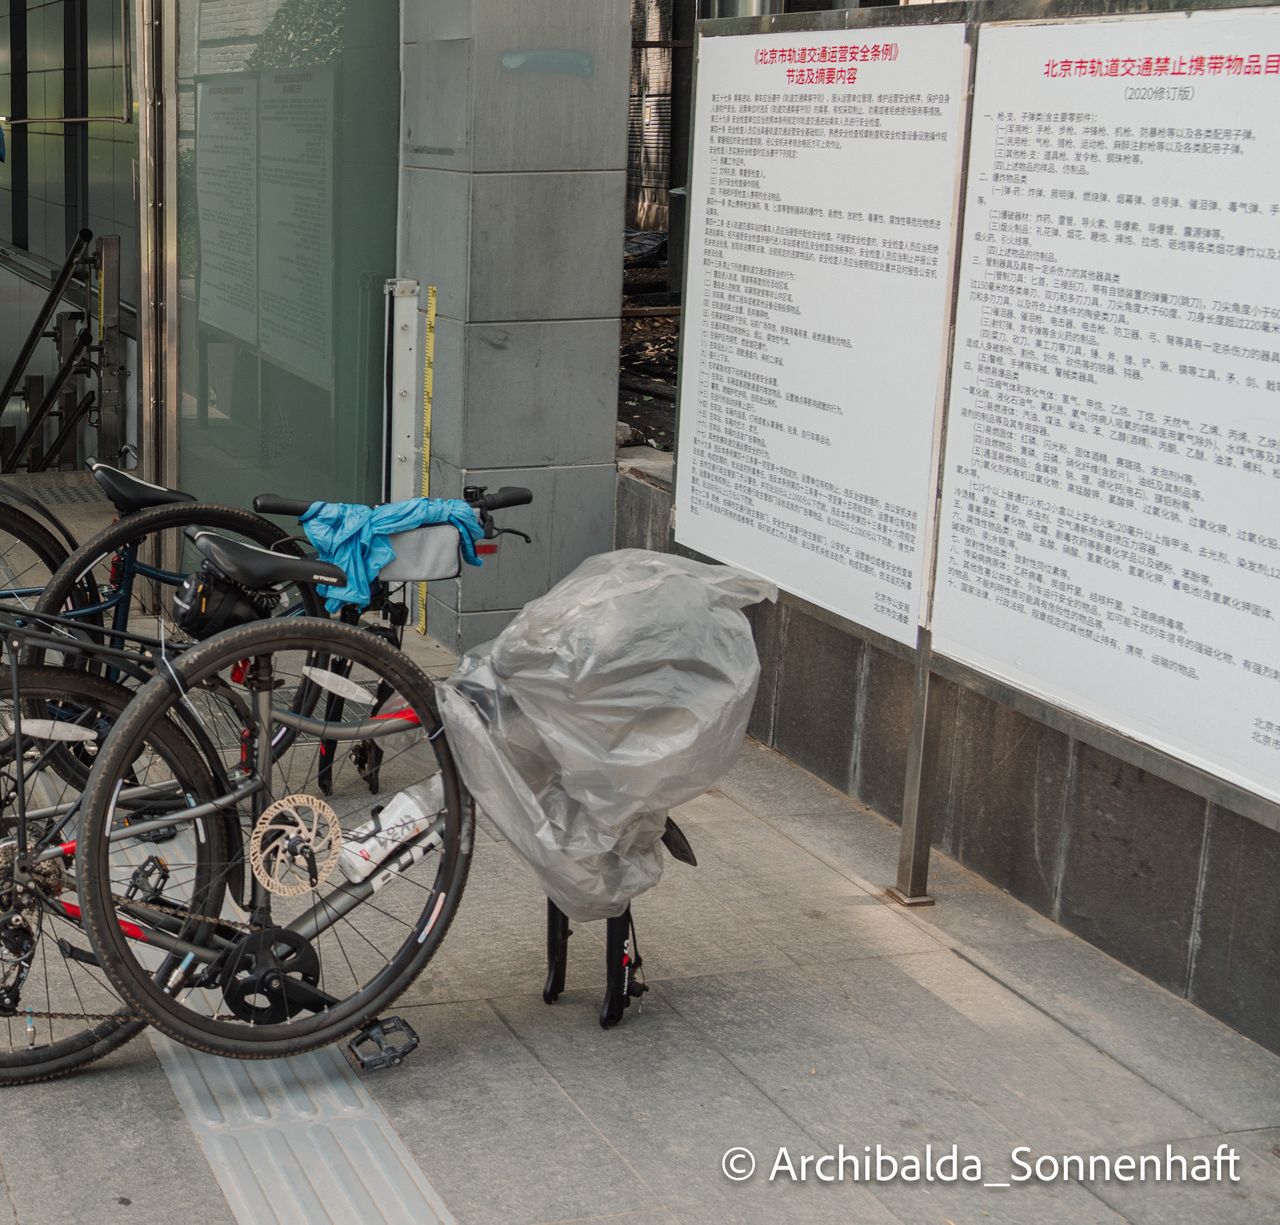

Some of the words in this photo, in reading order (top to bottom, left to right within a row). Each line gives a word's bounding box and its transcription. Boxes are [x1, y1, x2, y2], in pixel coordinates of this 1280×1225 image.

[754, 42, 899, 66] 《北京市轨道交通运营安全条例》
[786, 66, 858, 86] 节选及摘要内容
